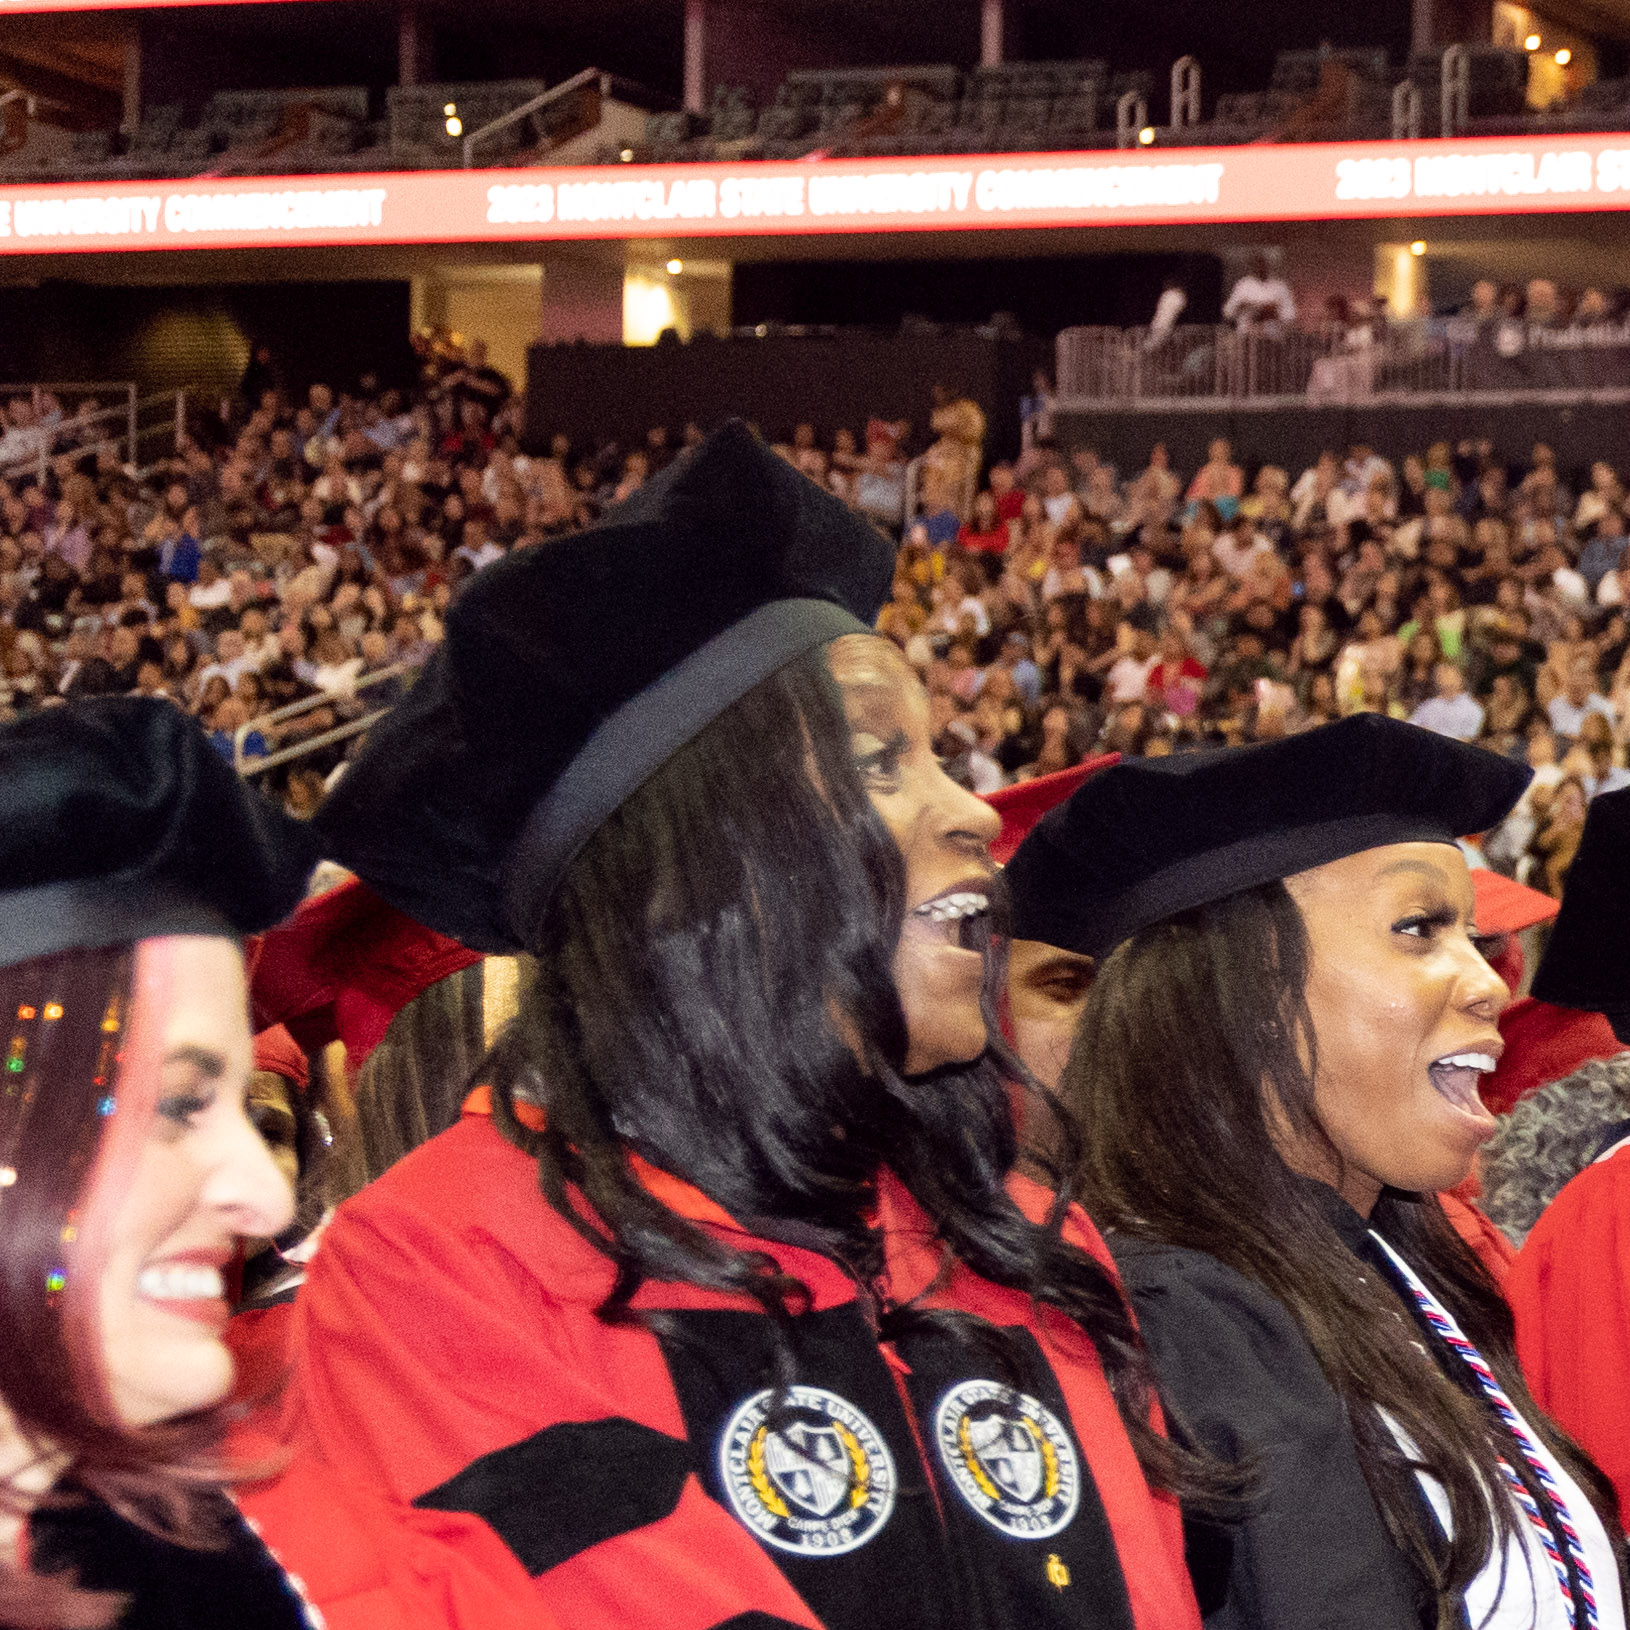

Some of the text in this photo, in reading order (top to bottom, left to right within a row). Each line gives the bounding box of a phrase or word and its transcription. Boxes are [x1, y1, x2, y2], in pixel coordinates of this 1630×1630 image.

[557, 180, 715, 221] MONTCLAIR
[720, 177, 805, 217] STATE
[809, 172, 973, 215] UNIVERSITY
[977, 164, 1223, 211] COMMENCEMENT
[1414, 152, 1591, 196] MONTCLAIR
[14, 196, 161, 237] UNIVERSITY
[165, 188, 386, 233] COMMENCEMENT
[729, 1405, 778, 1531] MONTCLAIR
[827, 1399, 891, 1517] UNIVERSITY
[801, 1526, 854, 1547] 1908
